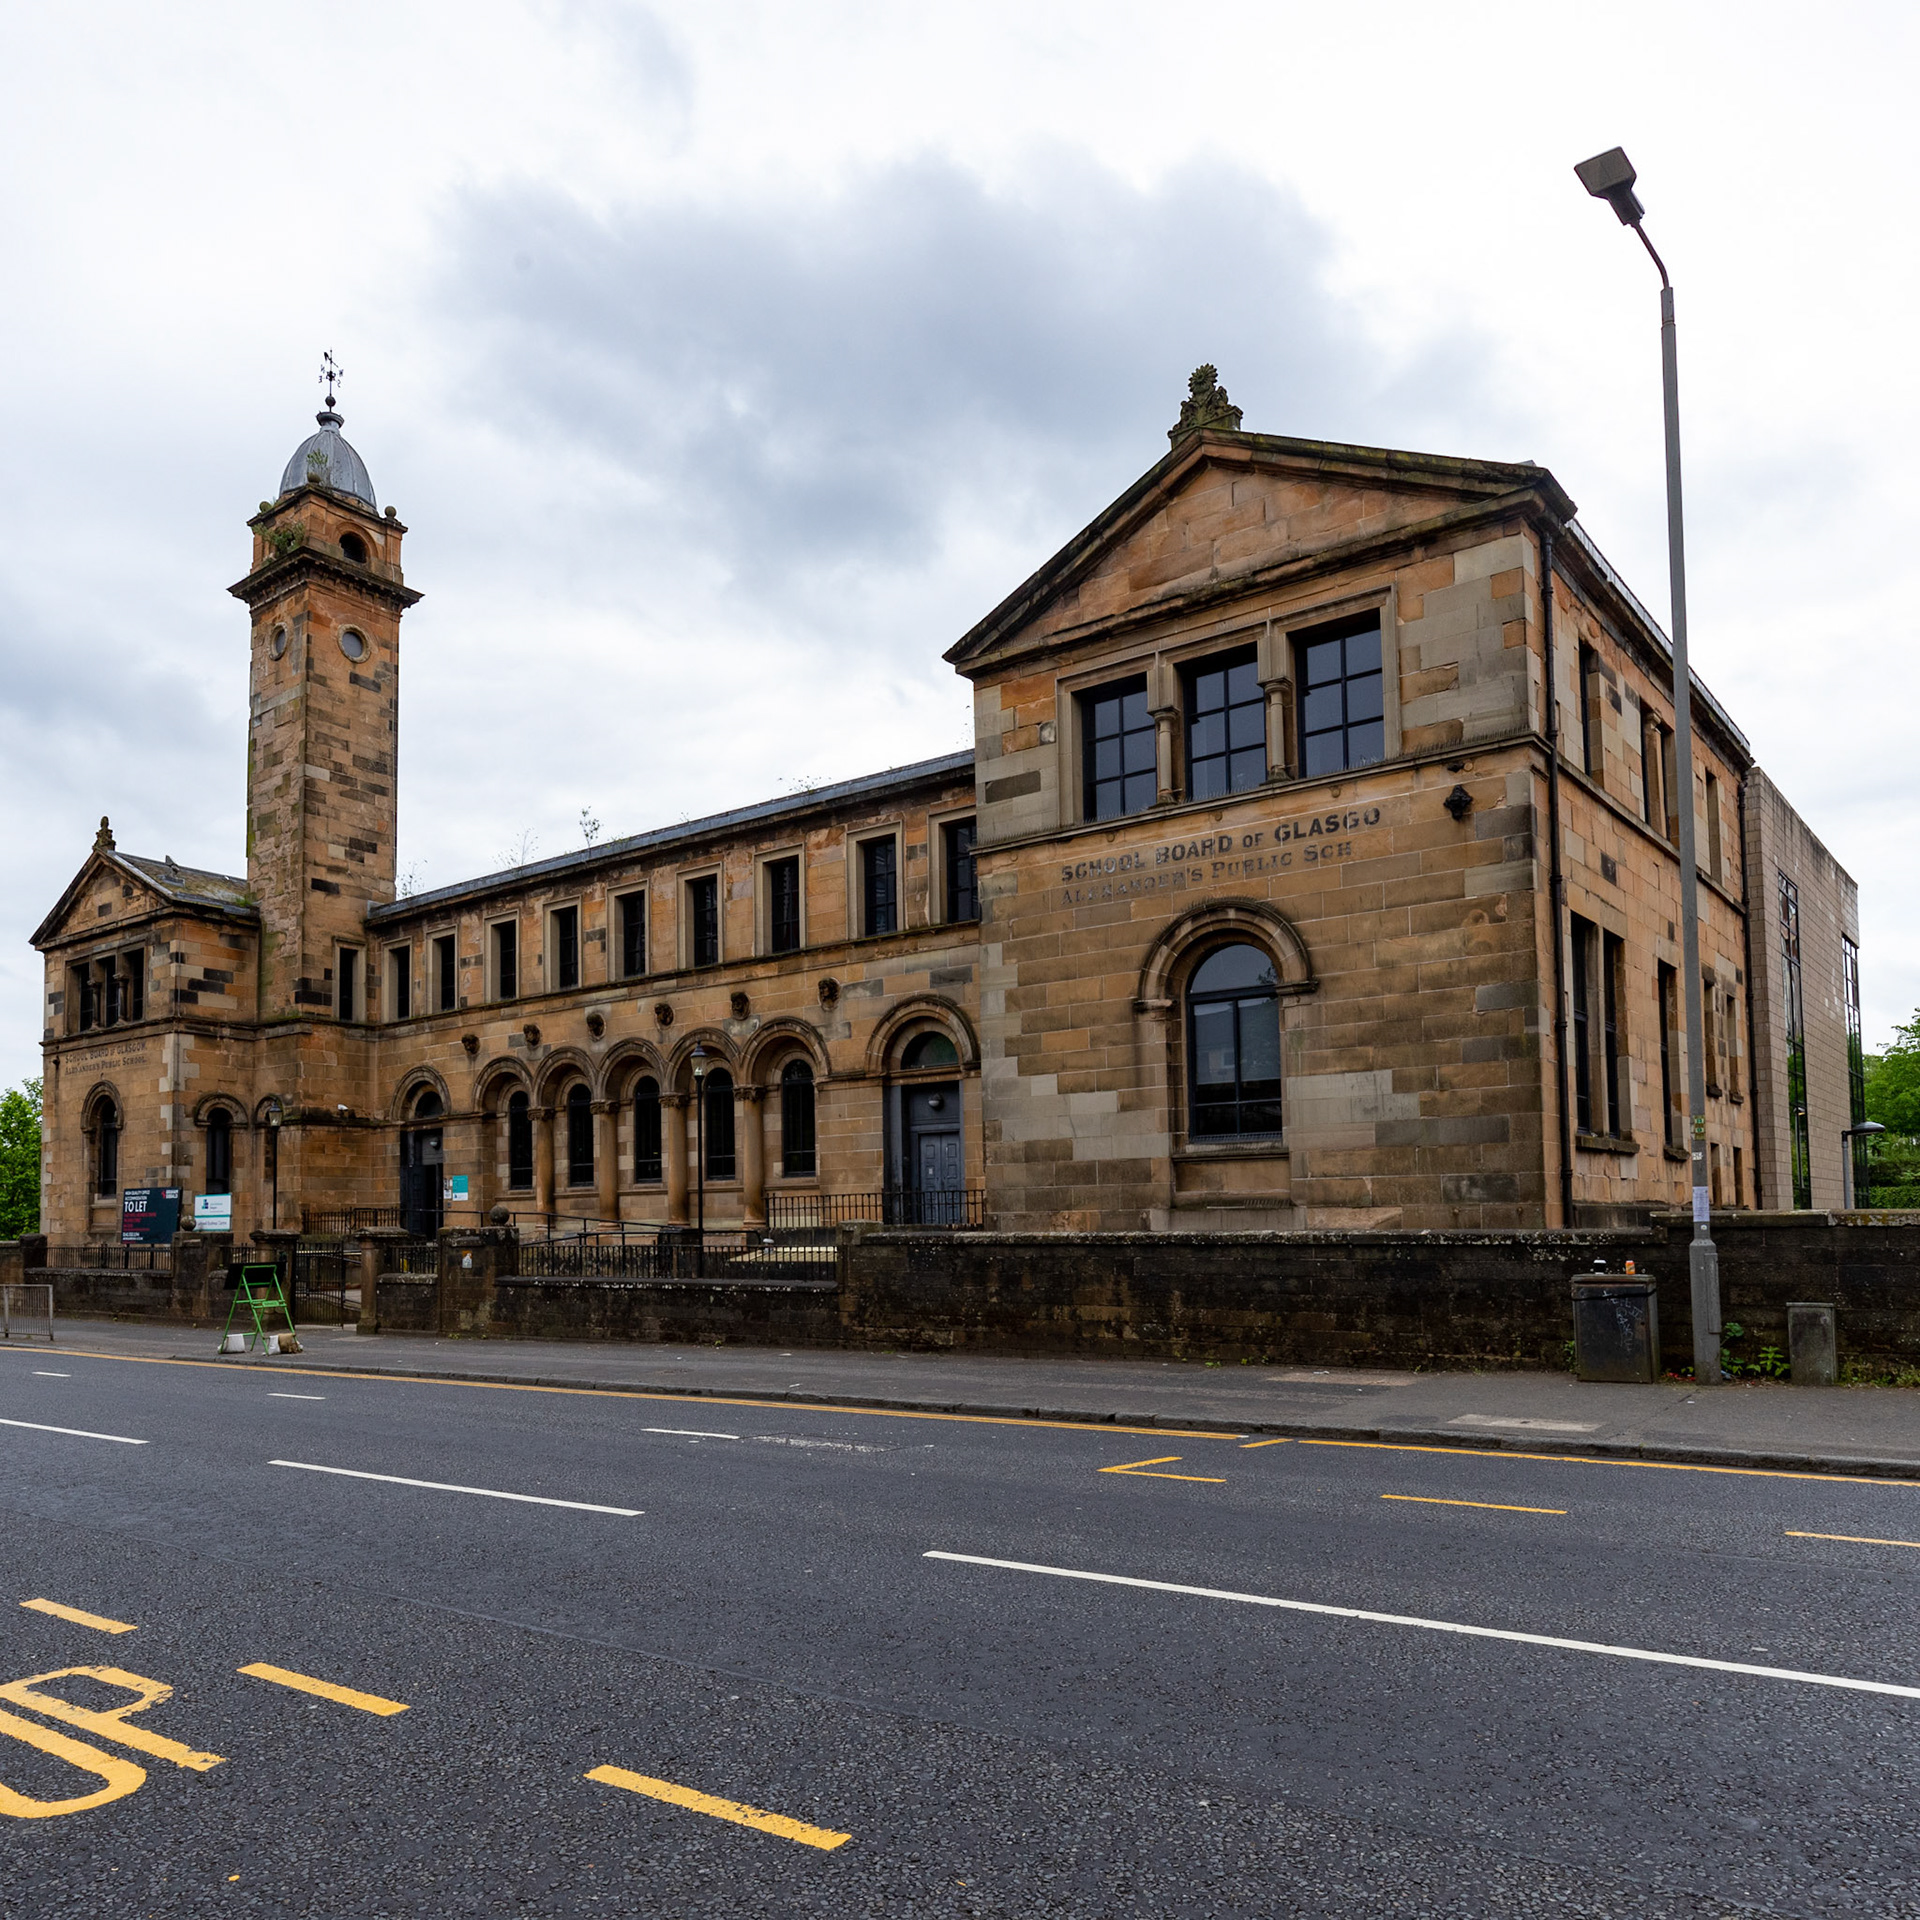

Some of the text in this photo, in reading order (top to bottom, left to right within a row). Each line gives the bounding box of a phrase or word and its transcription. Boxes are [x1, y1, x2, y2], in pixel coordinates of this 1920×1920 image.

[1061, 851, 1145, 882] SCHOOL
[1155, 835, 1233, 865] BOARD
[65, 1052, 88, 1064] SCHOOL
[90, 1047, 108, 1060] BOARD
[124, 1200, 148, 1213] TO LET
